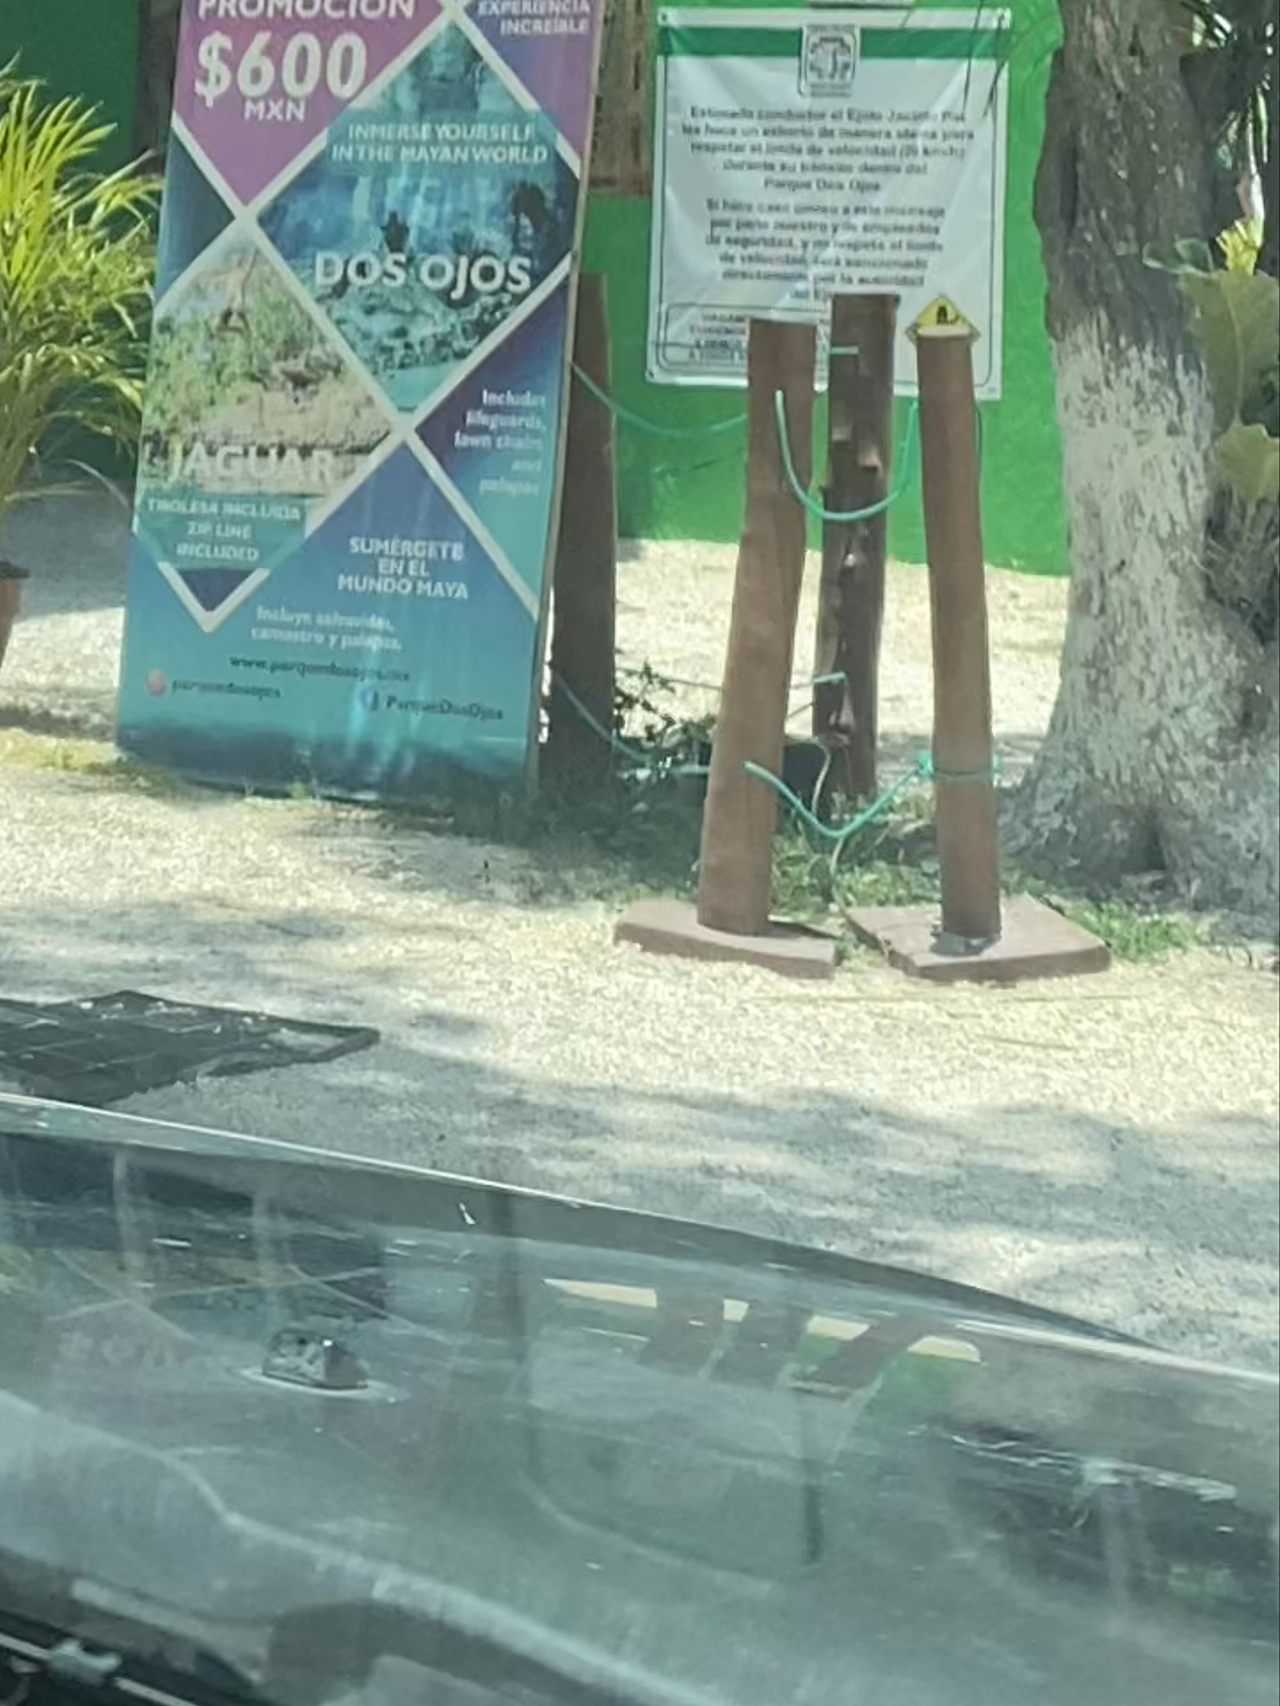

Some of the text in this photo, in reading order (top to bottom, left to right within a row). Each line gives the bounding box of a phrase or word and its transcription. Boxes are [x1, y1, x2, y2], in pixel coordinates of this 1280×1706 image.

[195, 31, 367, 108] $600
[243, 99, 306, 122] MXN
[434, 122, 536, 143] YOURSELF
[331, 144, 549, 164] IN THE MAYAN WORLD
[315, 250, 533, 300] DOS OJOS
[166, 440, 336, 485] JAGUAR
[147, 497, 301, 521] TIROLESA INCLUIDA
[187, 520, 253, 540] ZIP LINE
[176, 542, 260, 562] INCLUDED
[349, 534, 465, 562] SUMÉRGETE
[377, 557, 431, 578] EN EL
[337, 573, 469, 600] MUNDO MAYA
